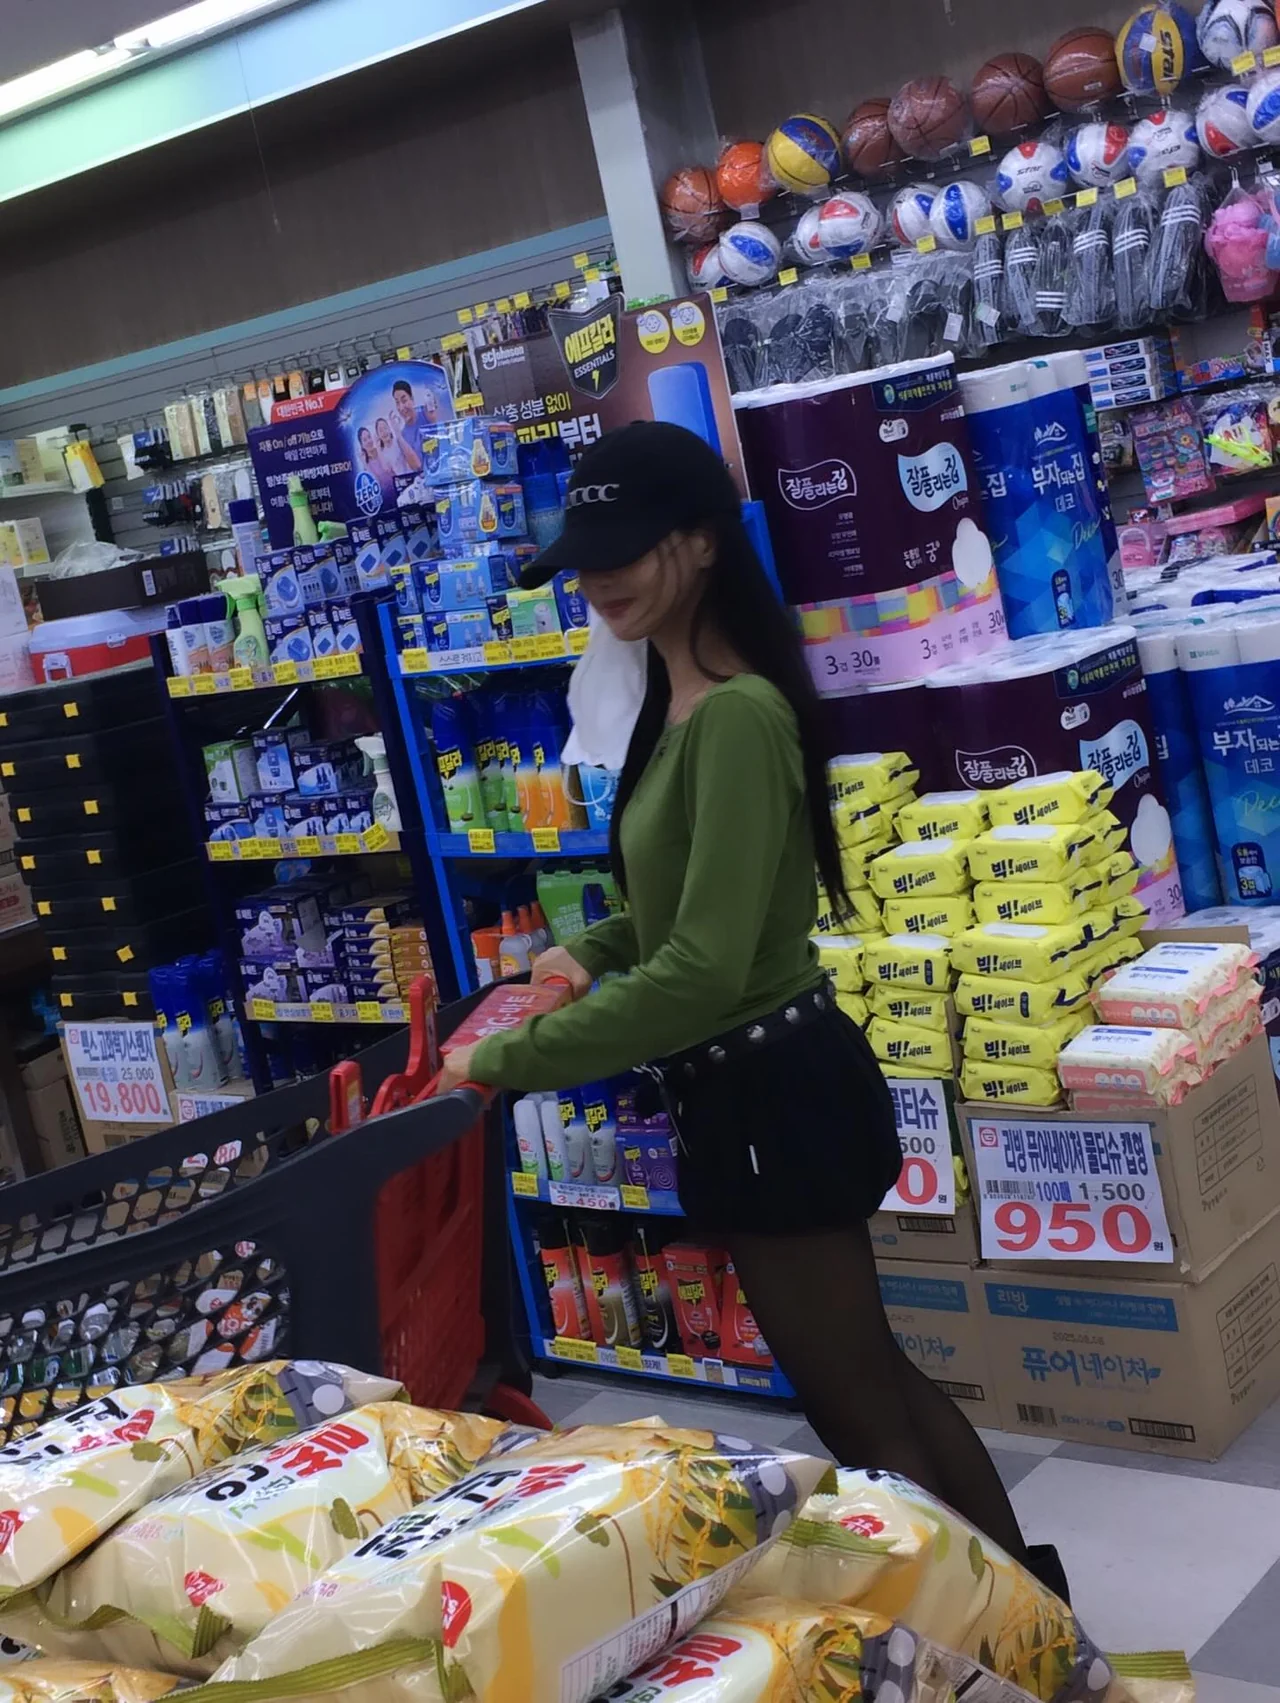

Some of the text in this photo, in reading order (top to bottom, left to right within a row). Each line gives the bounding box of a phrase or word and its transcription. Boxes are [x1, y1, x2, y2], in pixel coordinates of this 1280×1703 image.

[564, 313, 616, 365] 에프킬라
[573, 350, 615, 379] ESSENTIALS
[519, 398, 545, 420] 성분
[545, 391, 572, 414] 없이
[785, 467, 849, 501] 잘풀리는집
[906, 454, 960, 498] 잘풀리는집
[1032, 451, 1086, 495] 부자되는집
[1055, 493, 1077, 513] 데코
[1213, 725, 1280, 757] 부자되는
[963, 755, 1028, 784] 잘풀리는집
[1244, 757, 1275, 776] 데코
[84, 1081, 161, 1116] 19,800
[1001, 1129, 1027, 1173] 리빙
[1084, 1131, 1123, 1175] 물티슈
[1120, 1132, 1149, 1176] 캡형
[1036, 1181, 1147, 1203] 100매 1,500
[994, 1201, 1164, 1255] 950 원
